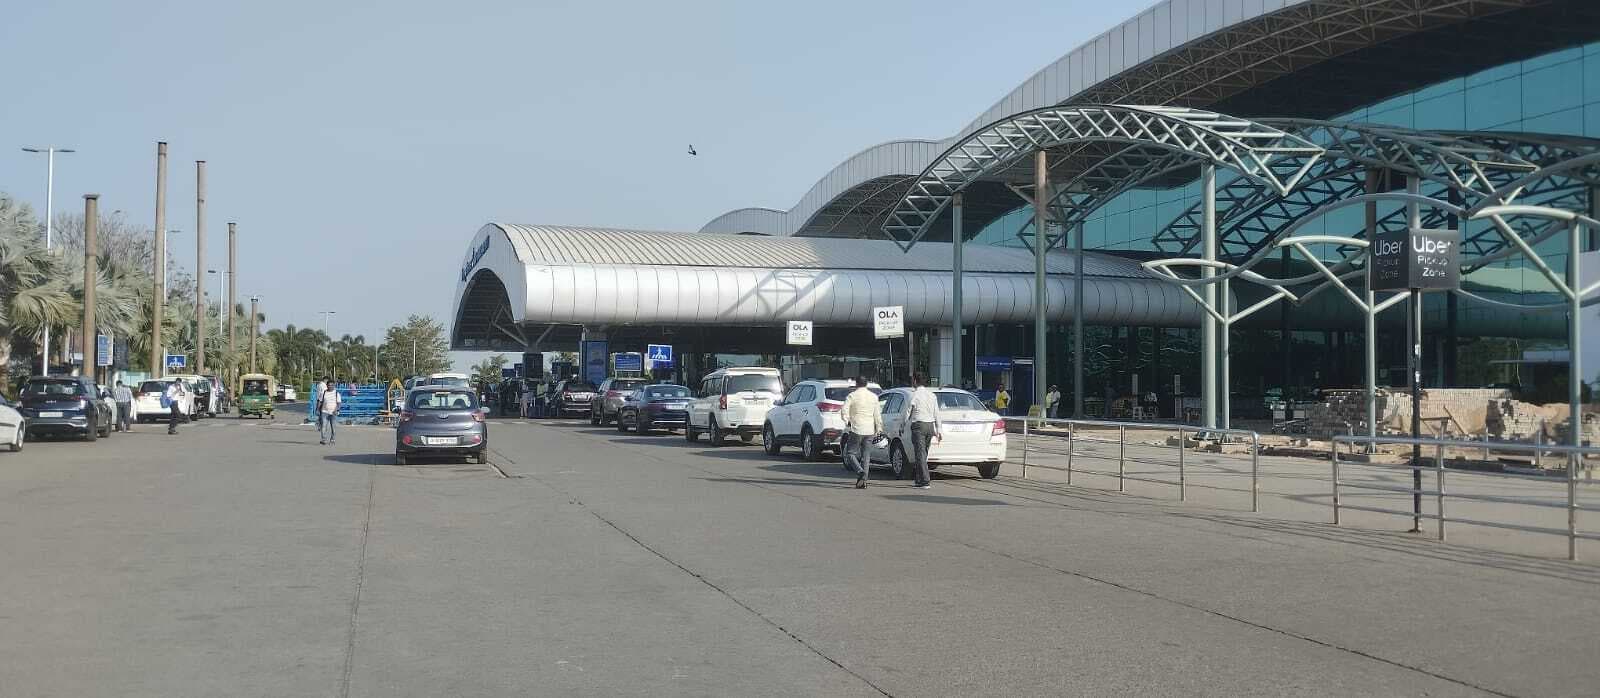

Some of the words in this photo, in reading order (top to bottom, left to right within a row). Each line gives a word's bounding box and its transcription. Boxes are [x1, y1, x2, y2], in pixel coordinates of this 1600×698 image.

[1374, 239, 1403, 256] Uber
[1422, 267, 1447, 277] Zone
[878, 310, 898, 319] OLA
